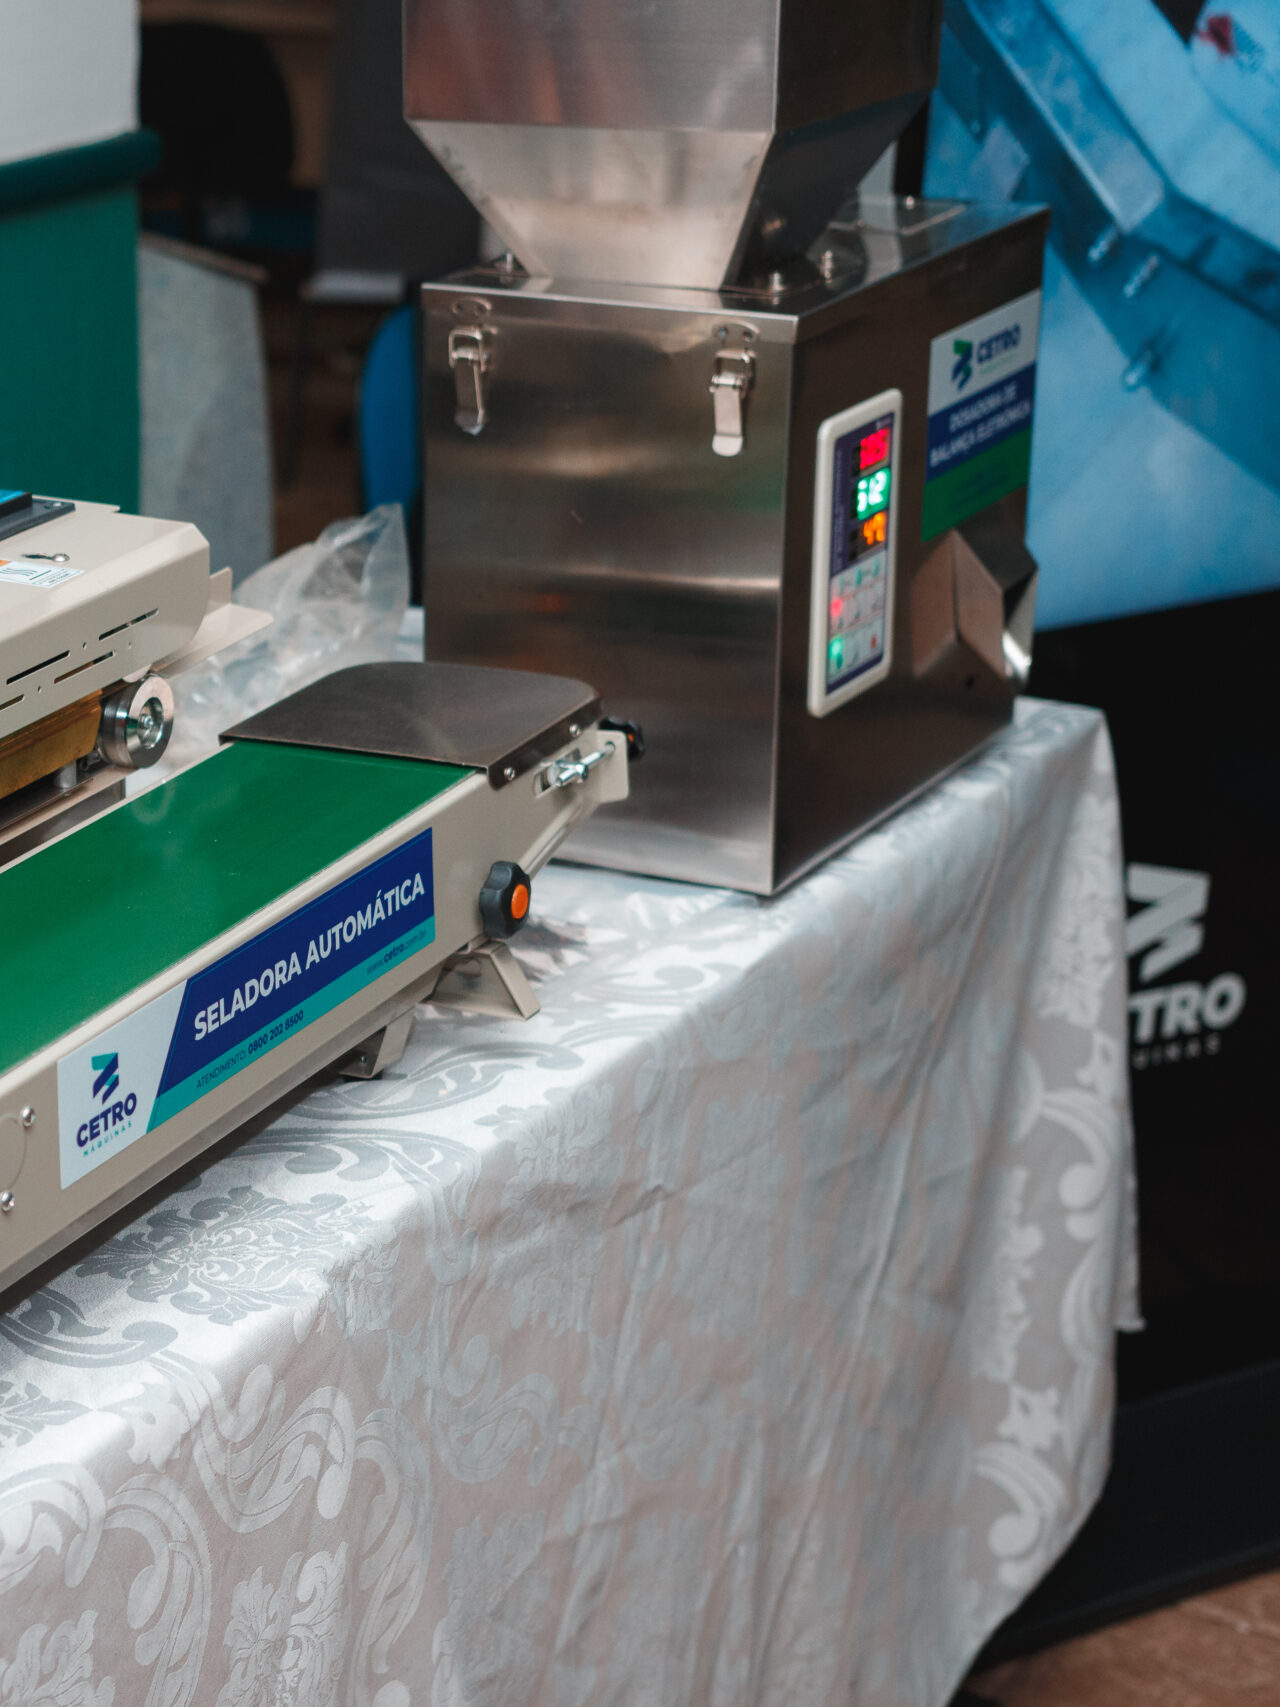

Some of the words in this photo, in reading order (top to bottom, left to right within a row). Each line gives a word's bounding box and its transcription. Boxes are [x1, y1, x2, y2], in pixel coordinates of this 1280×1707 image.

[976, 322, 1021, 364] CETRO
[929, 431, 975, 468] BALANÇA
[194, 951, 302, 1041] SELADORA
[305, 872, 425, 971] AUTOMÁTICA
[366, 929, 427, 975] www.cetro.com.br
[1127, 973, 1246, 1045] TRO
[196, 1049, 247, 1090] ATENDIMENTO:
[248, 1033, 268, 1054] 0800
[270, 1025, 284, 1043] 202
[285, 1009, 304, 1035] 8500
[76, 1091, 138, 1149] CETRO
[82, 1120, 133, 1158] MÁQUINAS
